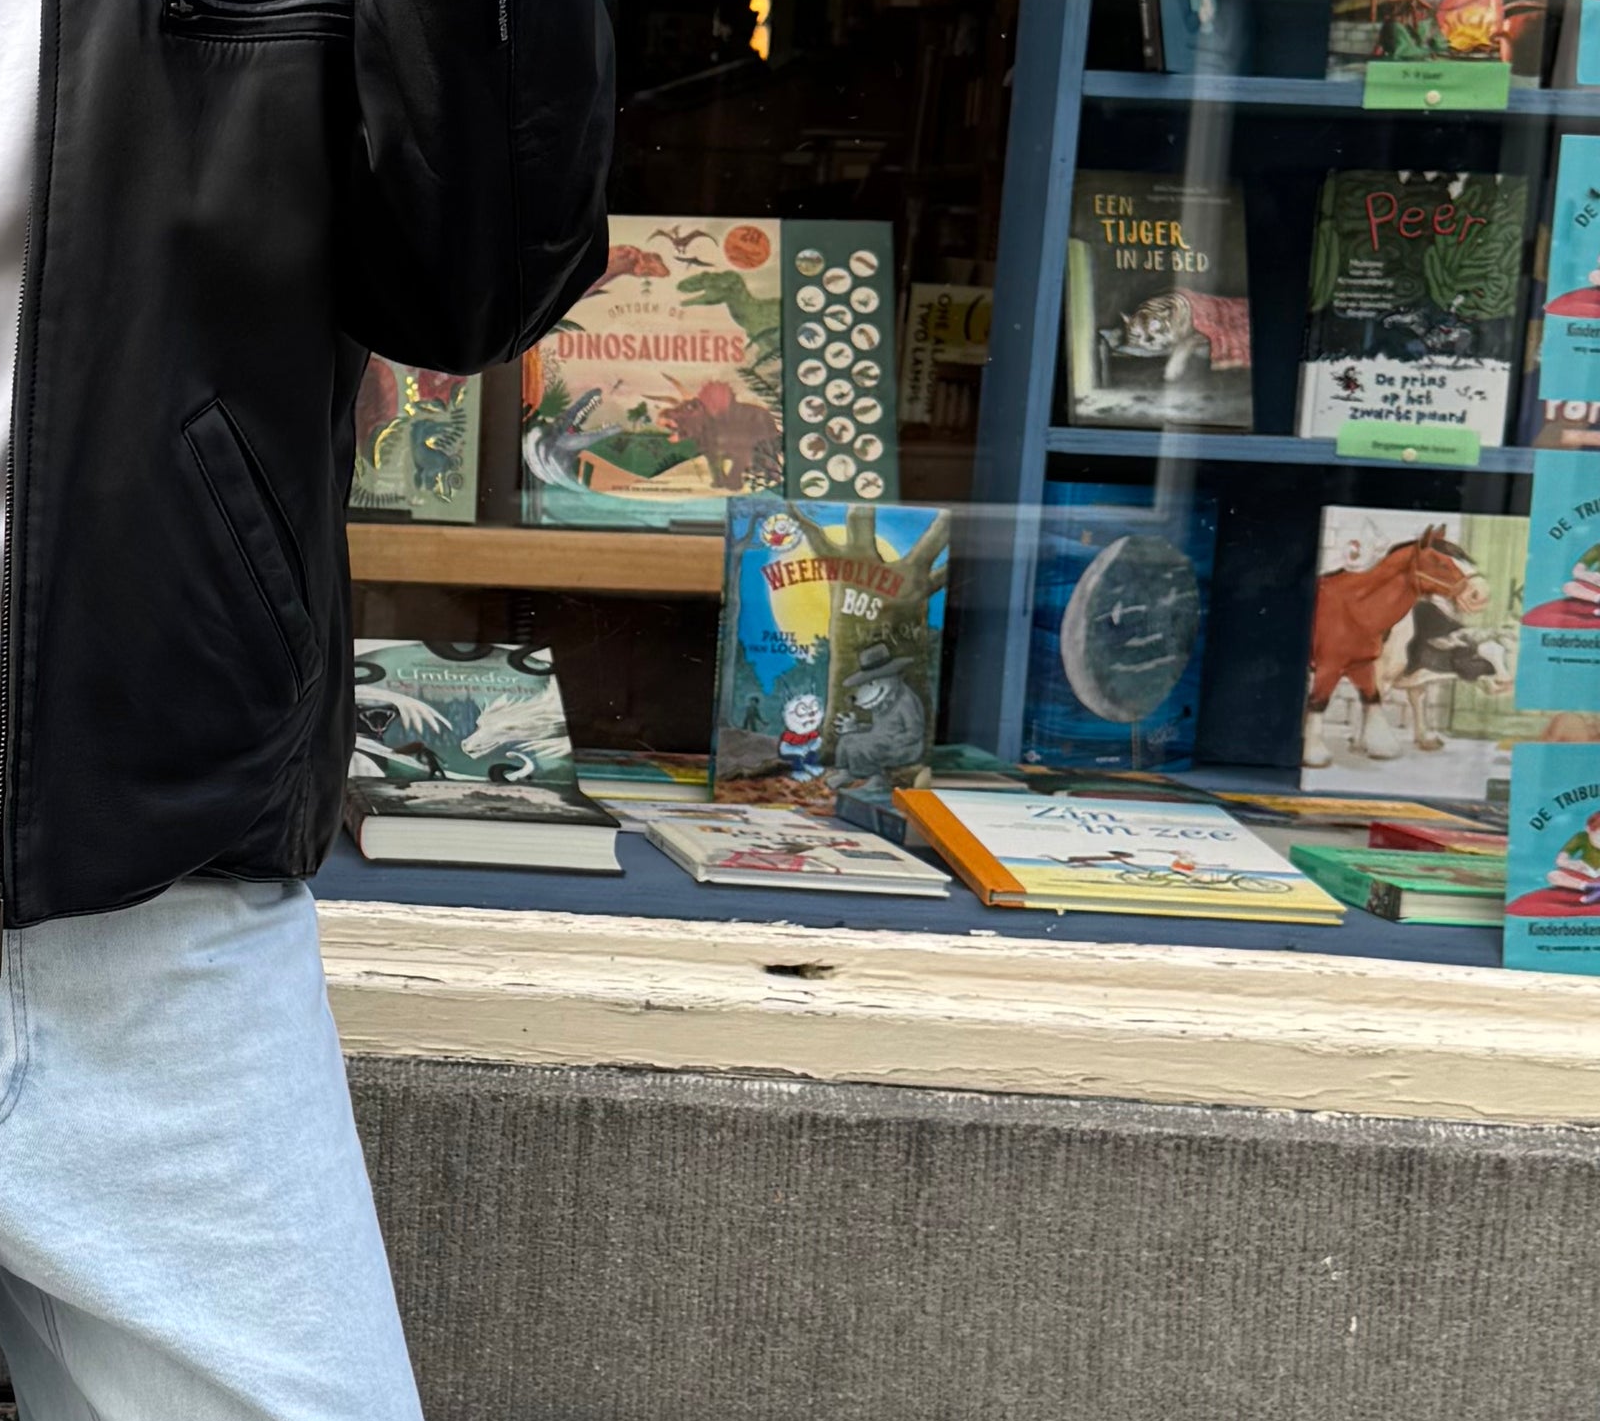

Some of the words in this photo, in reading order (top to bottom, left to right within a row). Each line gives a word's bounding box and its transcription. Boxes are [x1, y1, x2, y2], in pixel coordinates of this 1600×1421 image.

[1094, 194, 1134, 217] EEN
[1365, 191, 1486, 252] Peer
[1100, 220, 1191, 250] TIJGER
[1116, 249, 1138, 270] IN
[1143, 251, 1165, 271] JE
[1171, 252, 1210, 273] BED
[1374, 373, 1396, 386] De
[1401, 373, 1448, 392] prins
[1549, 517, 1573, 541] DE
[761, 556, 906, 599] WEERWOLVEN
[841, 587, 883, 621] BOS
[763, 630, 797, 643] PAUL
[770, 643, 811, 656] LOON
[1025, 803, 1125, 823] Zin
[1528, 807, 1553, 832] DE
[1148, 826, 1238, 842] zee
